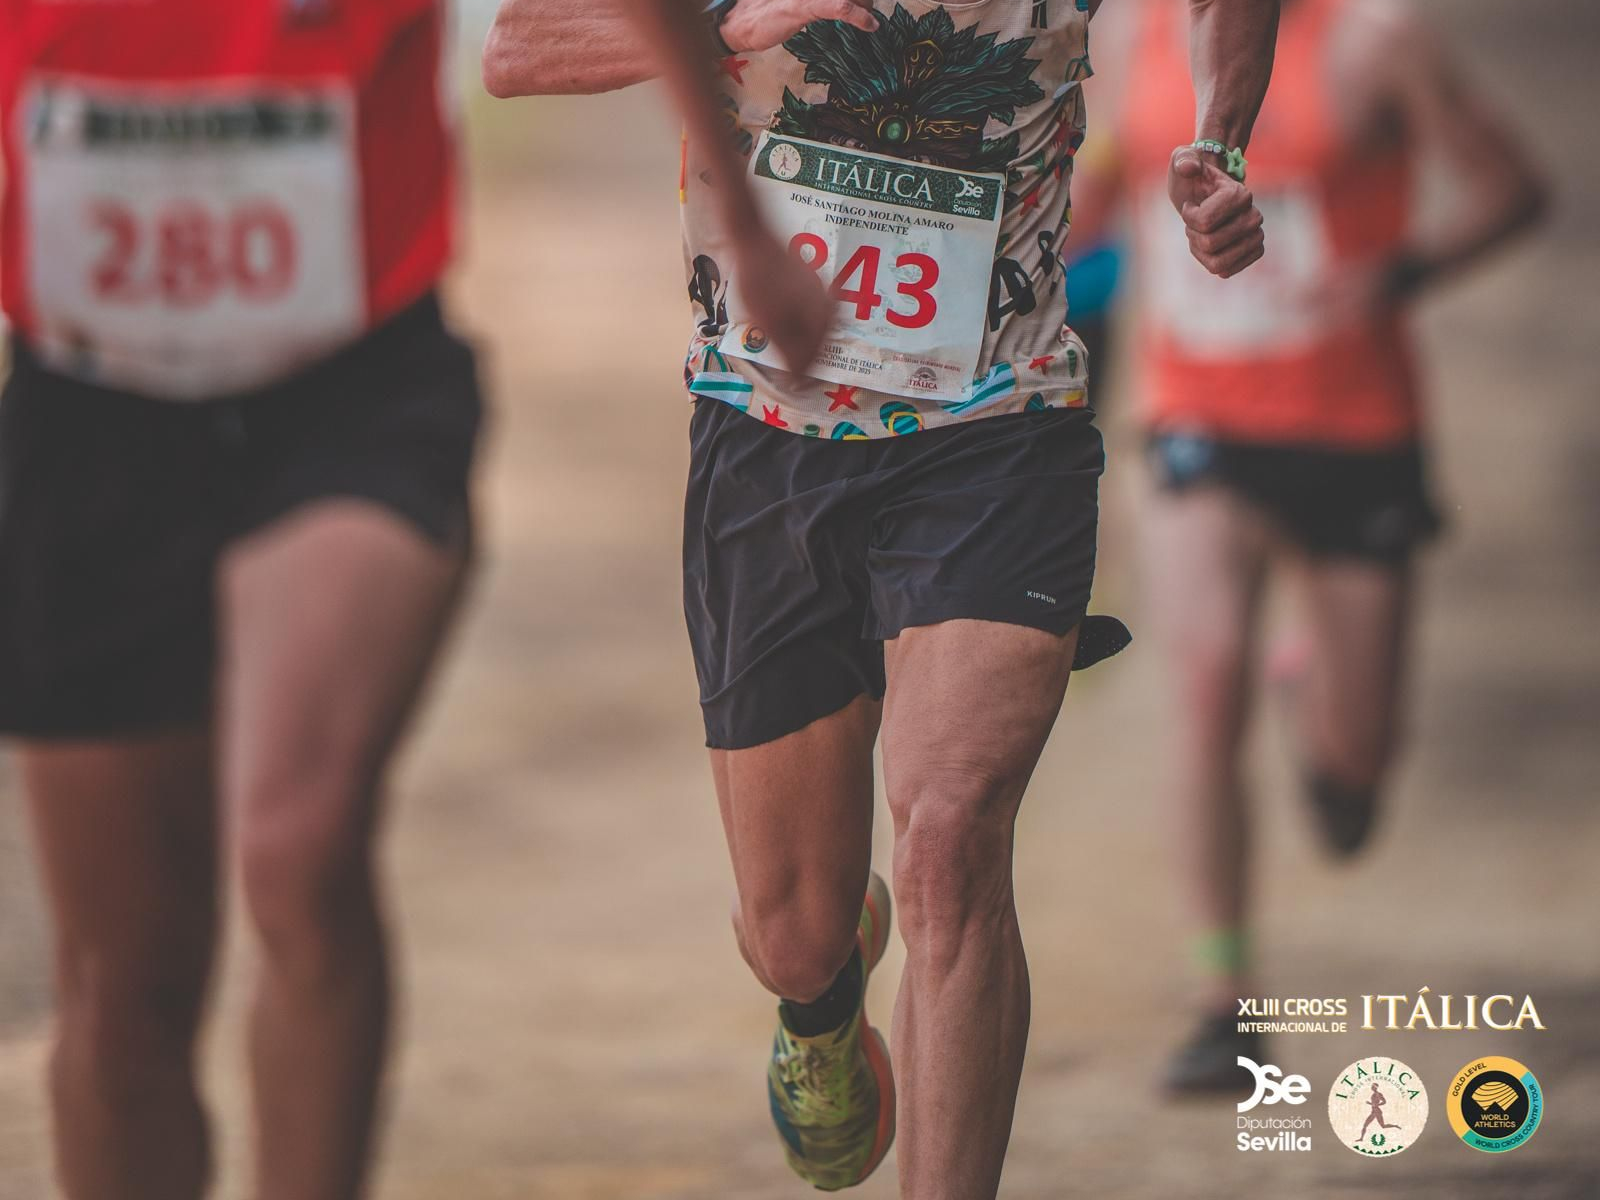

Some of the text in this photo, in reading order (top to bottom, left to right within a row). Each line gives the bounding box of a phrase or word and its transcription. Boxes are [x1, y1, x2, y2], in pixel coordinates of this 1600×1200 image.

[815, 157, 935, 203] ITÁLICA
[815, 182, 934, 210] INTERNATIONAL CROSS COUNTRY
[790, 192, 955, 232] JOSÉ SANTIAGO MOLINA AMARO
[952, 203, 980, 217] Sevilla
[824, 213, 909, 236] INDEPENDIENTE
[88, 195, 300, 310] 280
[858, 366, 872, 376] 2025
[859, 358, 883, 371] ITÁLICA
[909, 377, 938, 391] ITÁLICA
[1026, 590, 1057, 605] KIPRUN
